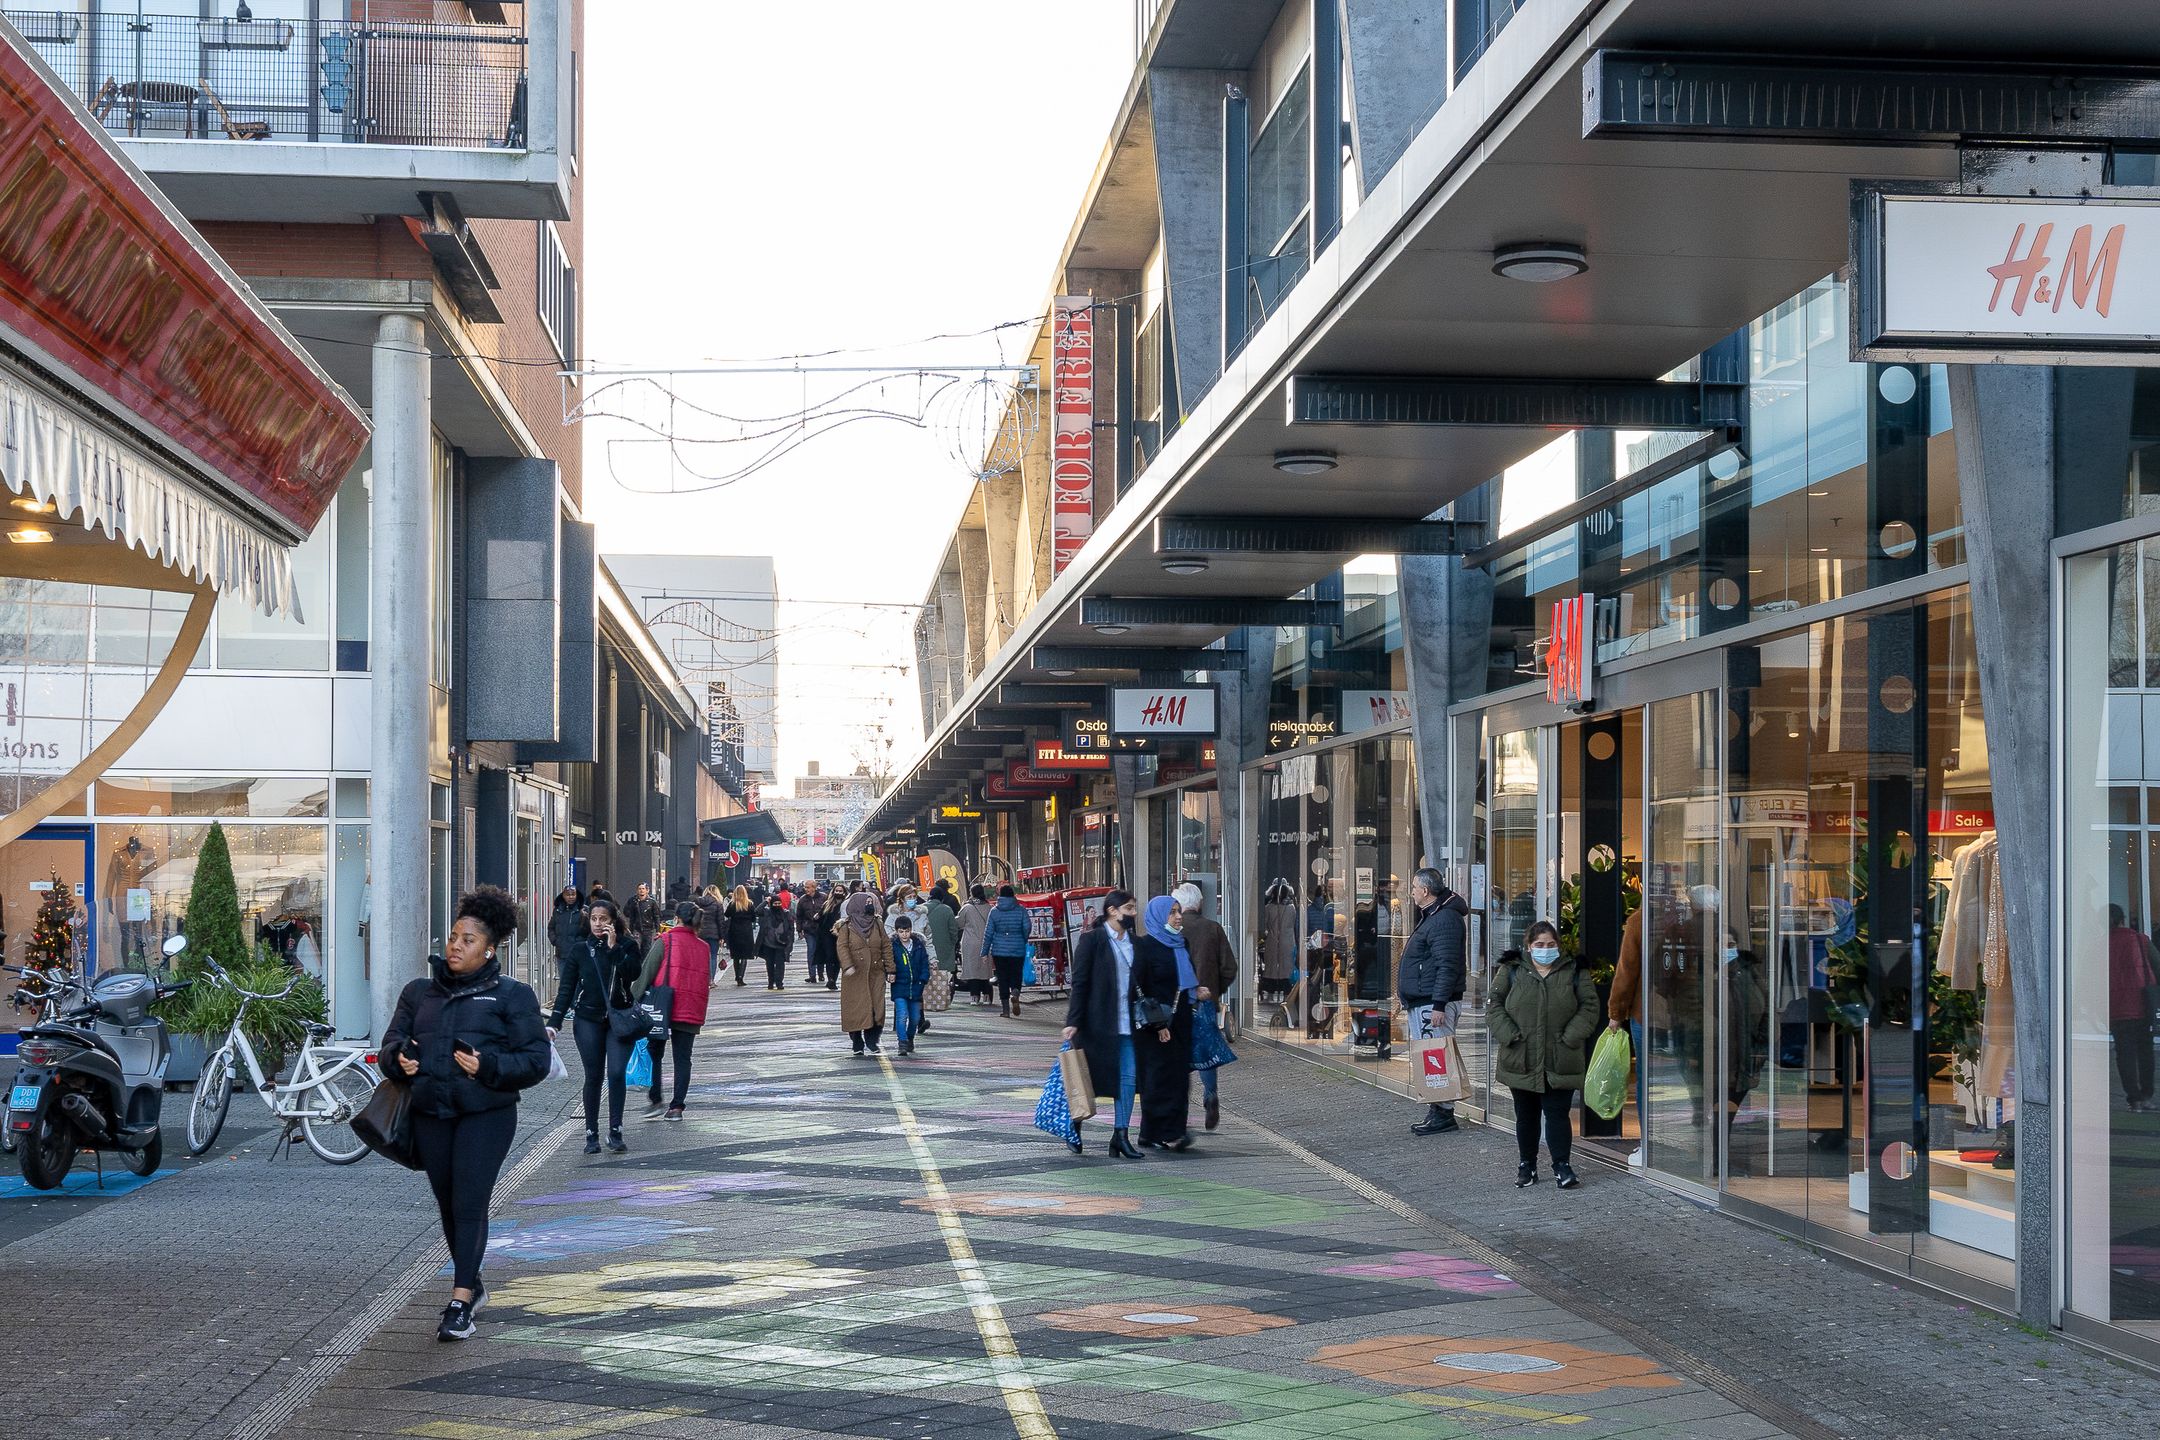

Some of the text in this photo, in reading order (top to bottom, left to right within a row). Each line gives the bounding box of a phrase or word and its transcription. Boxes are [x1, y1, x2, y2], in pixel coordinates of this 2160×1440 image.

[1986, 222, 2126, 318] H&M
[1054, 306, 1093, 418] FREE
[1054, 429, 1093, 516] FOR
[1141, 695, 1188, 727] H&M
[0, 736, 59, 759] ions
[1038, 749, 1056, 760] FIT
[1826, 815, 1853, 827] Sale
[1954, 814, 1984, 827] Sale
